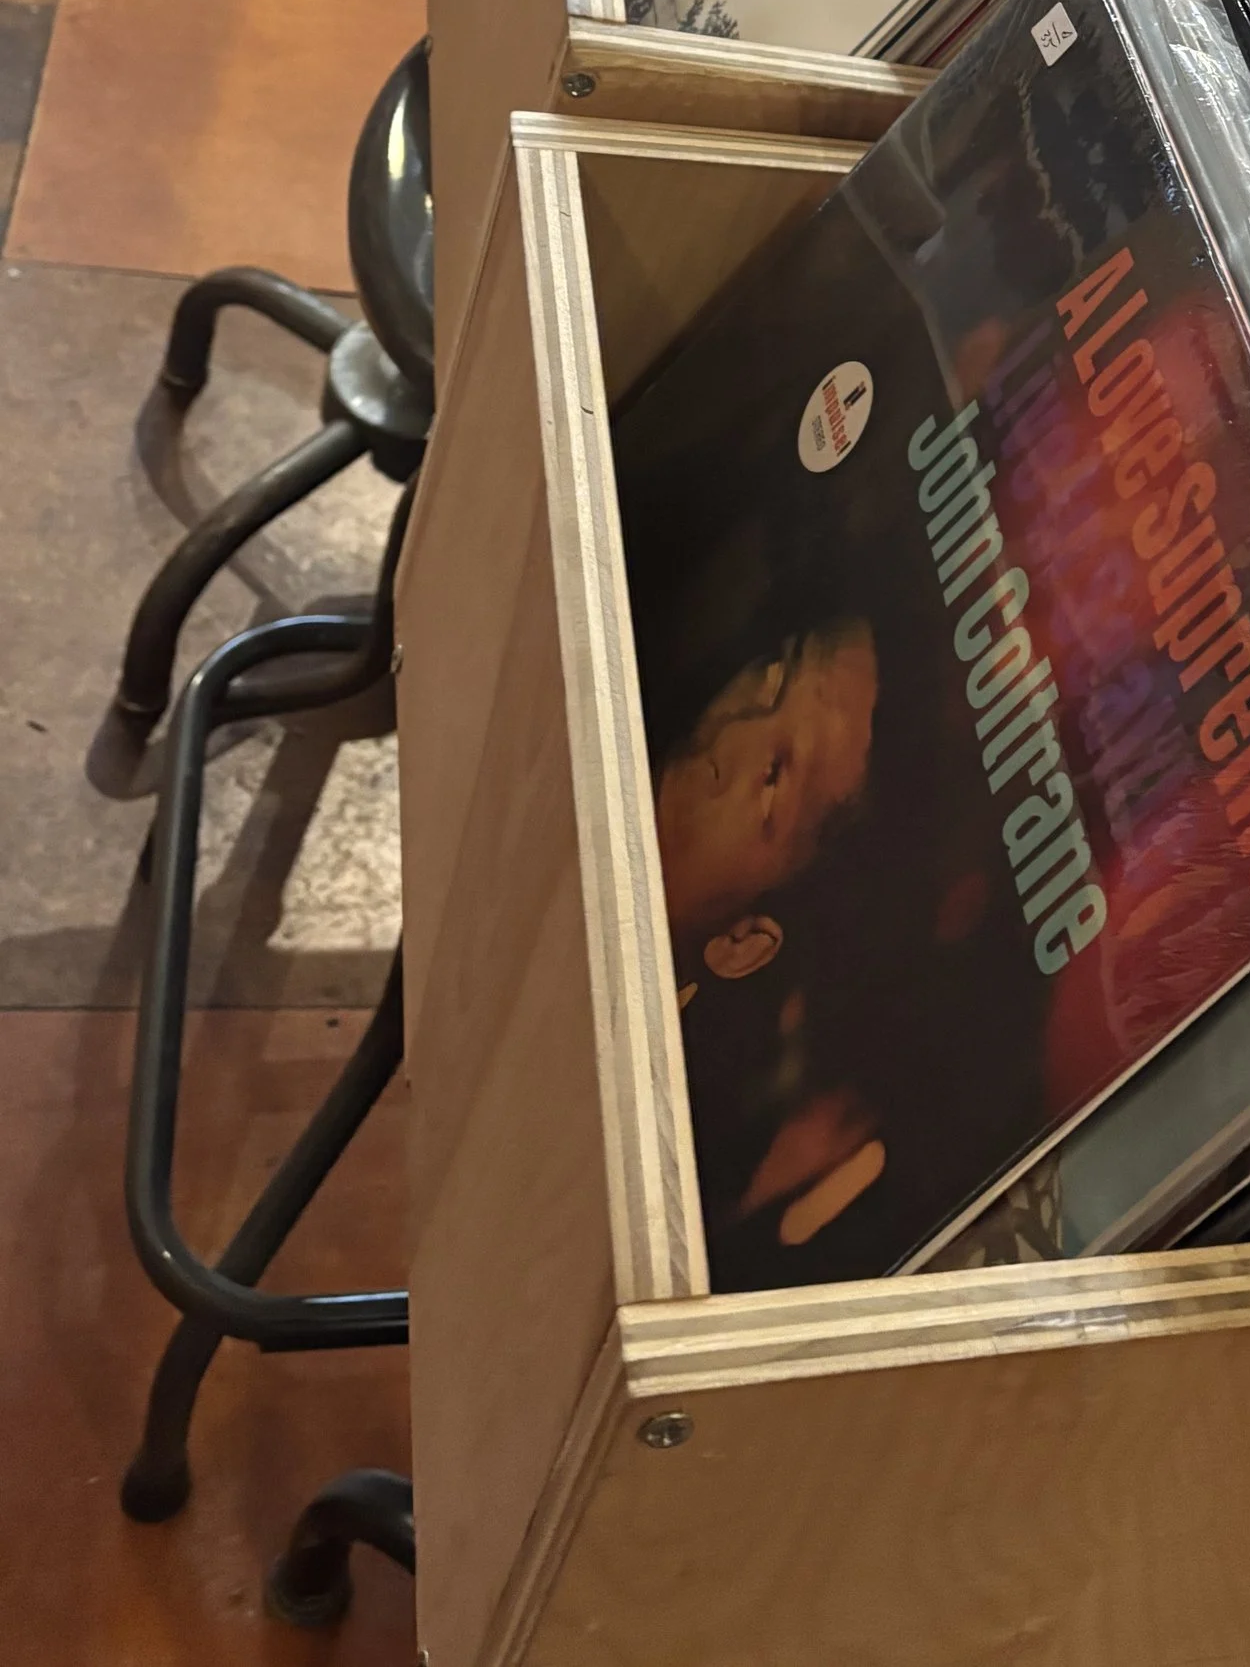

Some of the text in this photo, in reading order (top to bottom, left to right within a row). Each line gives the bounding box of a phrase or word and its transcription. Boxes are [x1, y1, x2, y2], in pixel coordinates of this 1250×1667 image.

[1055, 246, 1136, 341] A
[908, 399, 1109, 976] John Coltrane
